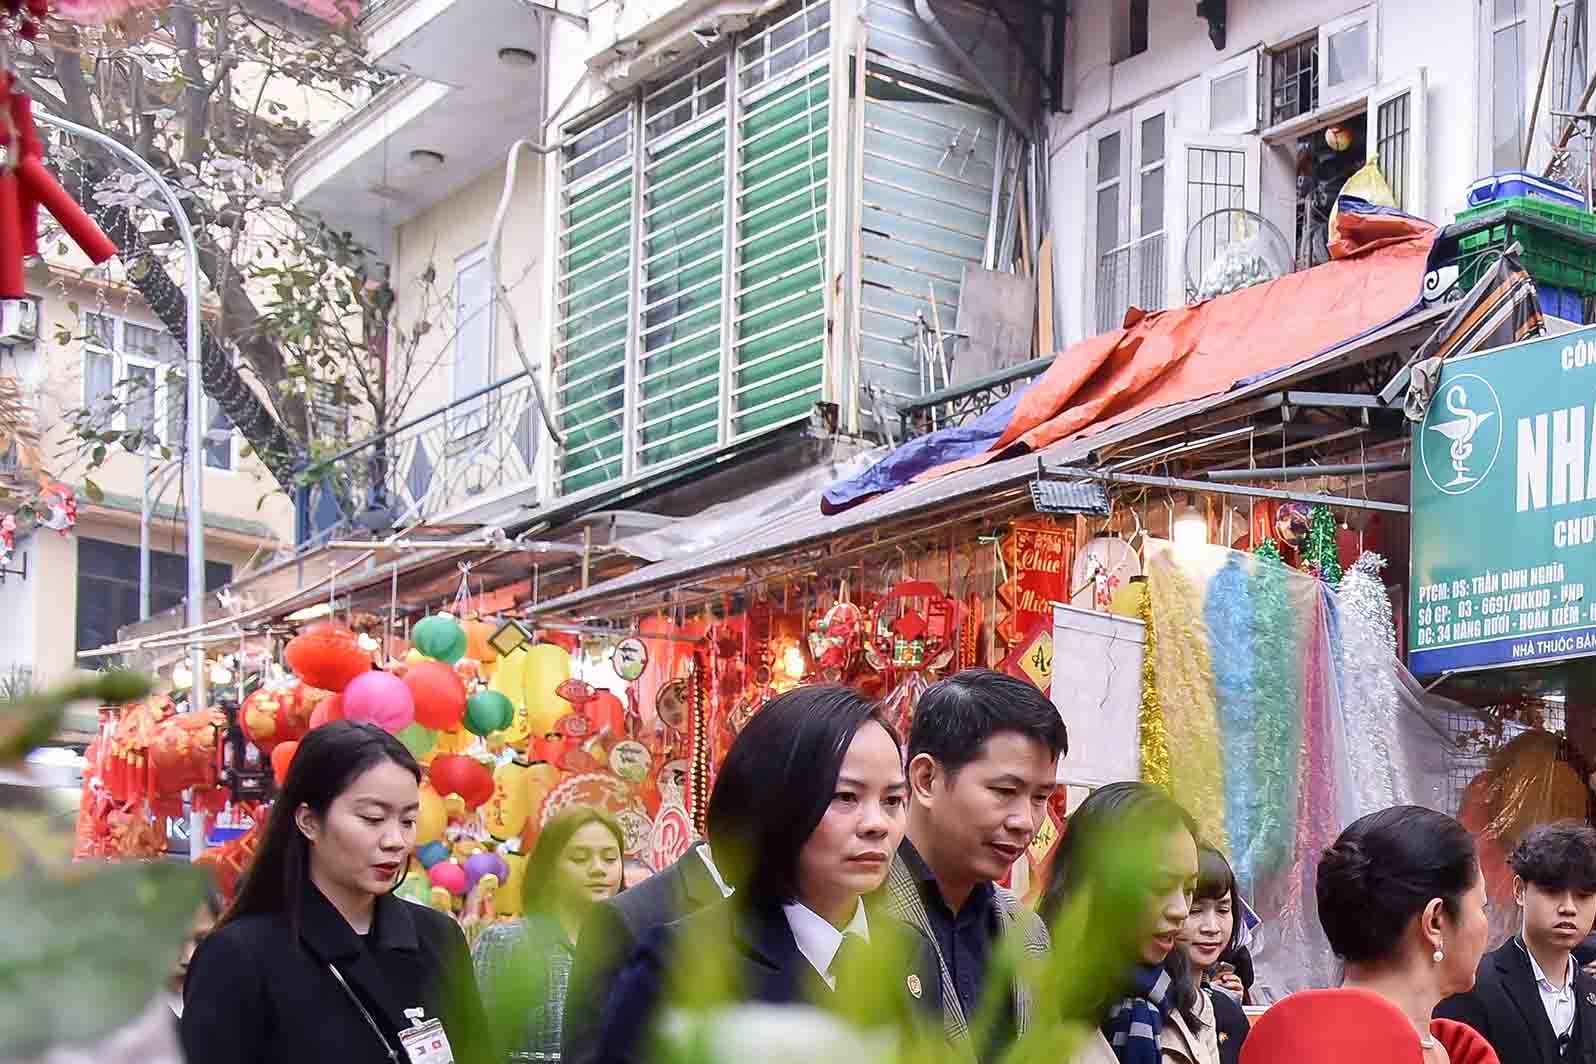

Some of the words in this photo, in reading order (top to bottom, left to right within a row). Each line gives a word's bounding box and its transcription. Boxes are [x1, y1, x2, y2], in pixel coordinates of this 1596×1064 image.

[1458, 601, 1472, 618] 03
[1437, 625, 1450, 642] 34
[1512, 642, 1535, 658] NHÀ
[1536, 636, 1575, 655] THUỐC
